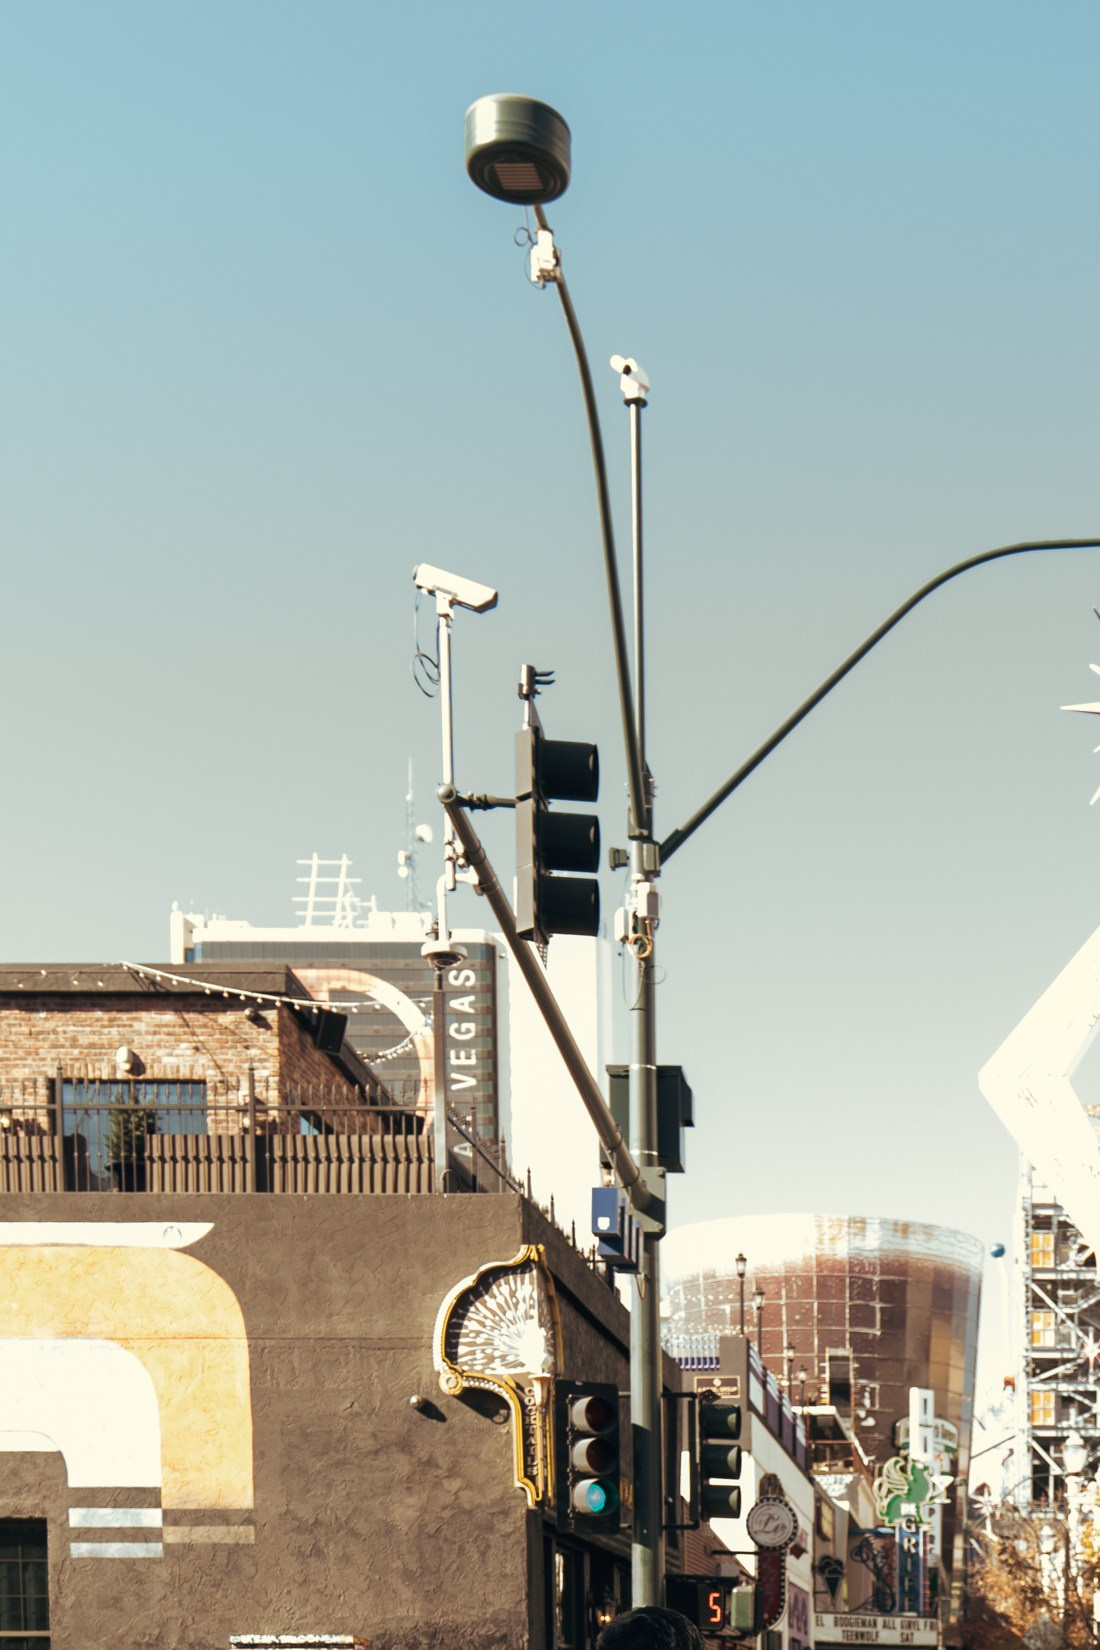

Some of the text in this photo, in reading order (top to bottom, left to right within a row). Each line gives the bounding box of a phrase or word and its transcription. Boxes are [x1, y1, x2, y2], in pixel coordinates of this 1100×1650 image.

[448, 968, 477, 1091] VEGAS
[709, 1592, 721, 1622] 5
[833, 1615, 878, 1630] BOOGIEMAN
[882, 1618, 897, 1631] ALL
[841, 1629, 915, 1643] TEENWOLF SAT
